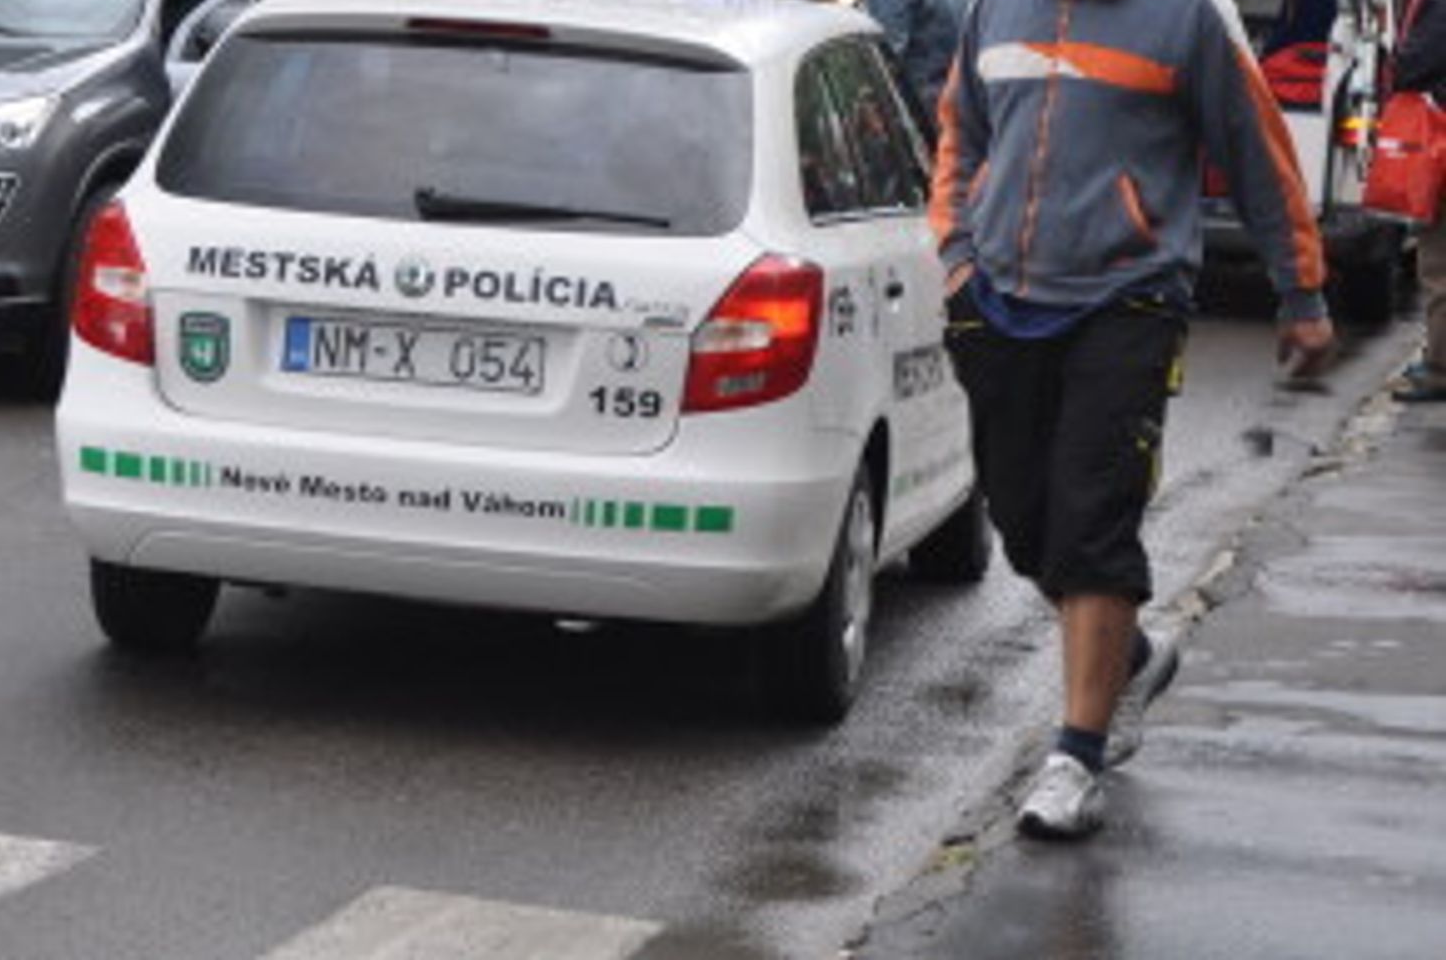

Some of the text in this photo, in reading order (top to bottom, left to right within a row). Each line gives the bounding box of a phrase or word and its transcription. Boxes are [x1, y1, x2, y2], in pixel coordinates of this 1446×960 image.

[187, 245, 616, 310] MESTSKÁ POLÍCIA
[450, 338, 534, 387] 054
[589, 386, 661, 418] 159
[221, 466, 565, 517] Nové Mesto nad Váhom
